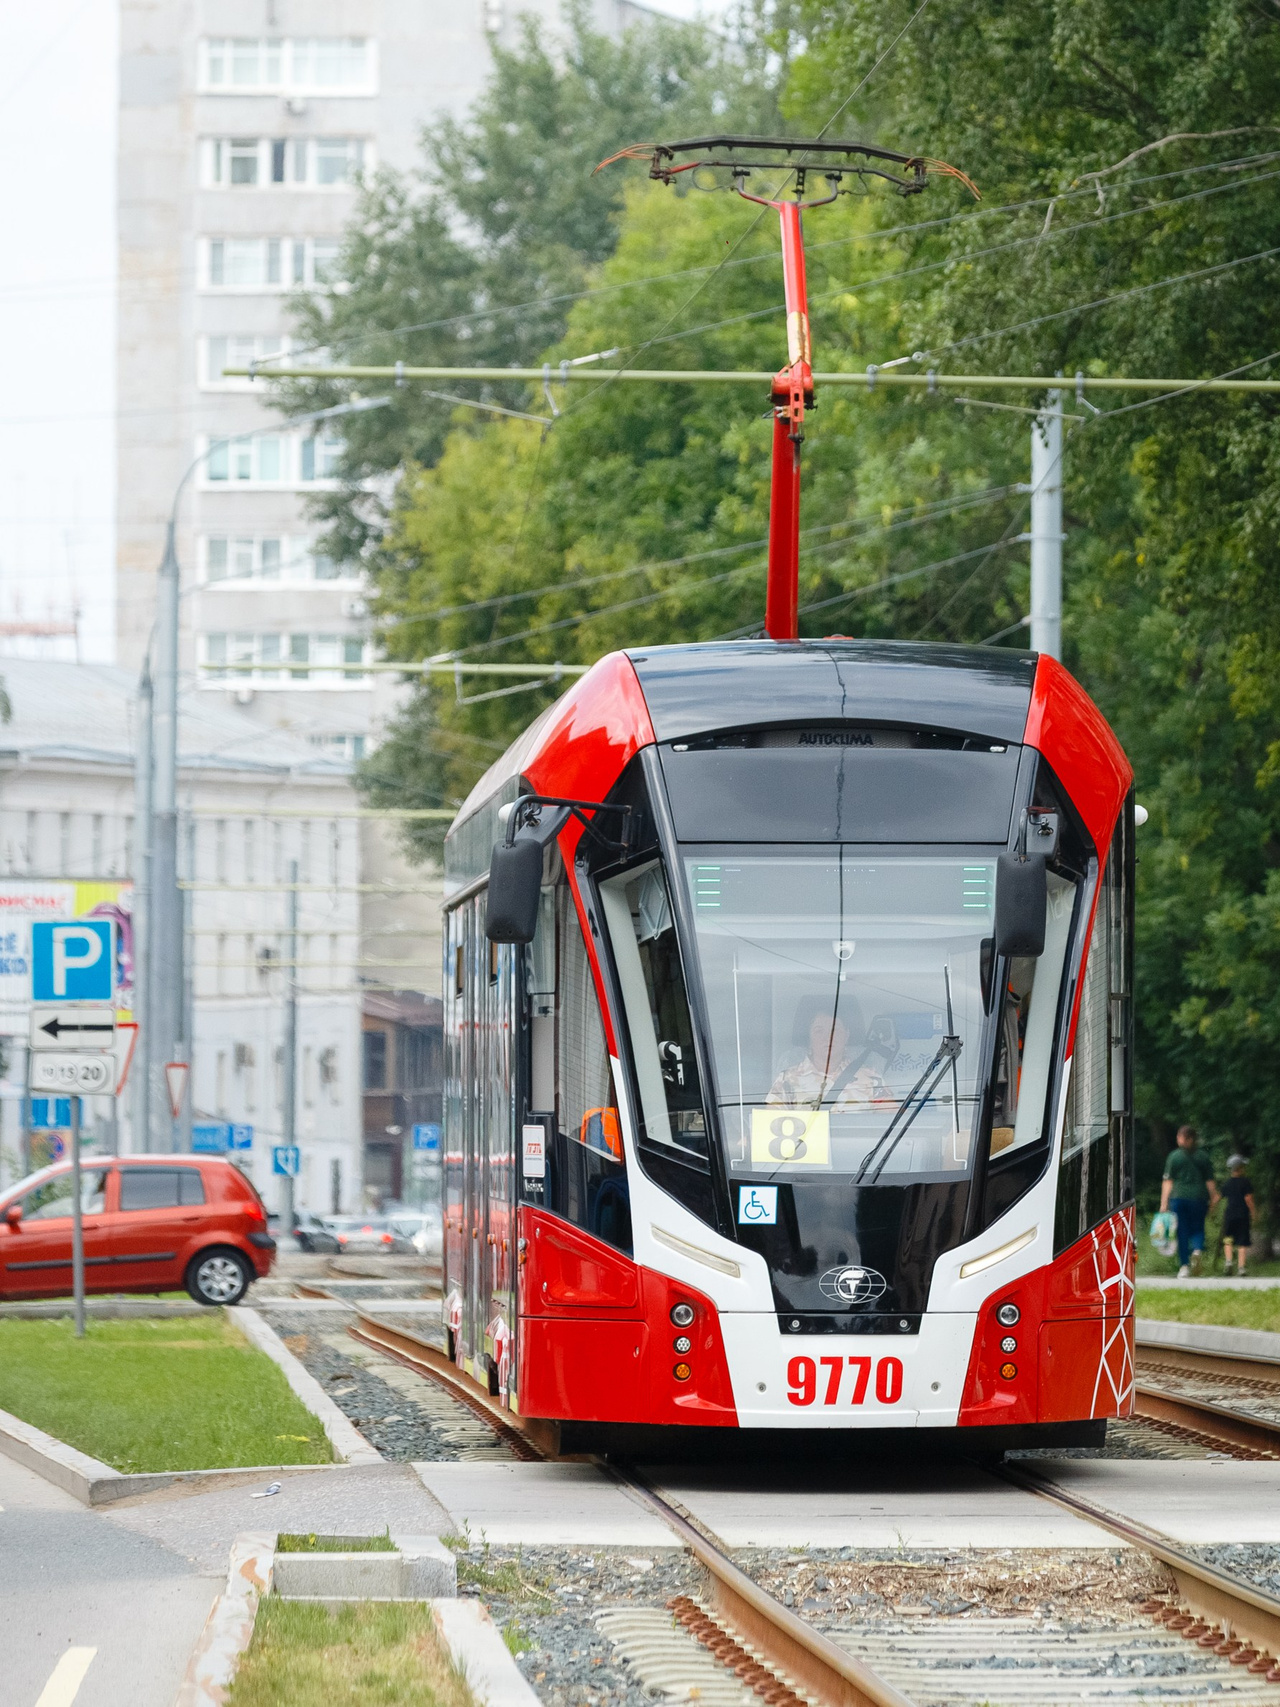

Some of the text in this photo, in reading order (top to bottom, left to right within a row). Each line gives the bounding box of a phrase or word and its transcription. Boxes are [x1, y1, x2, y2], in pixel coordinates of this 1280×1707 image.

[798, 732, 874, 746] AUTOCLIMA
[53, 926, 103, 996] P
[81, 1066, 101, 1081] 20
[768, 1116, 808, 1161] 8
[786, 1355, 904, 1407] 9770
